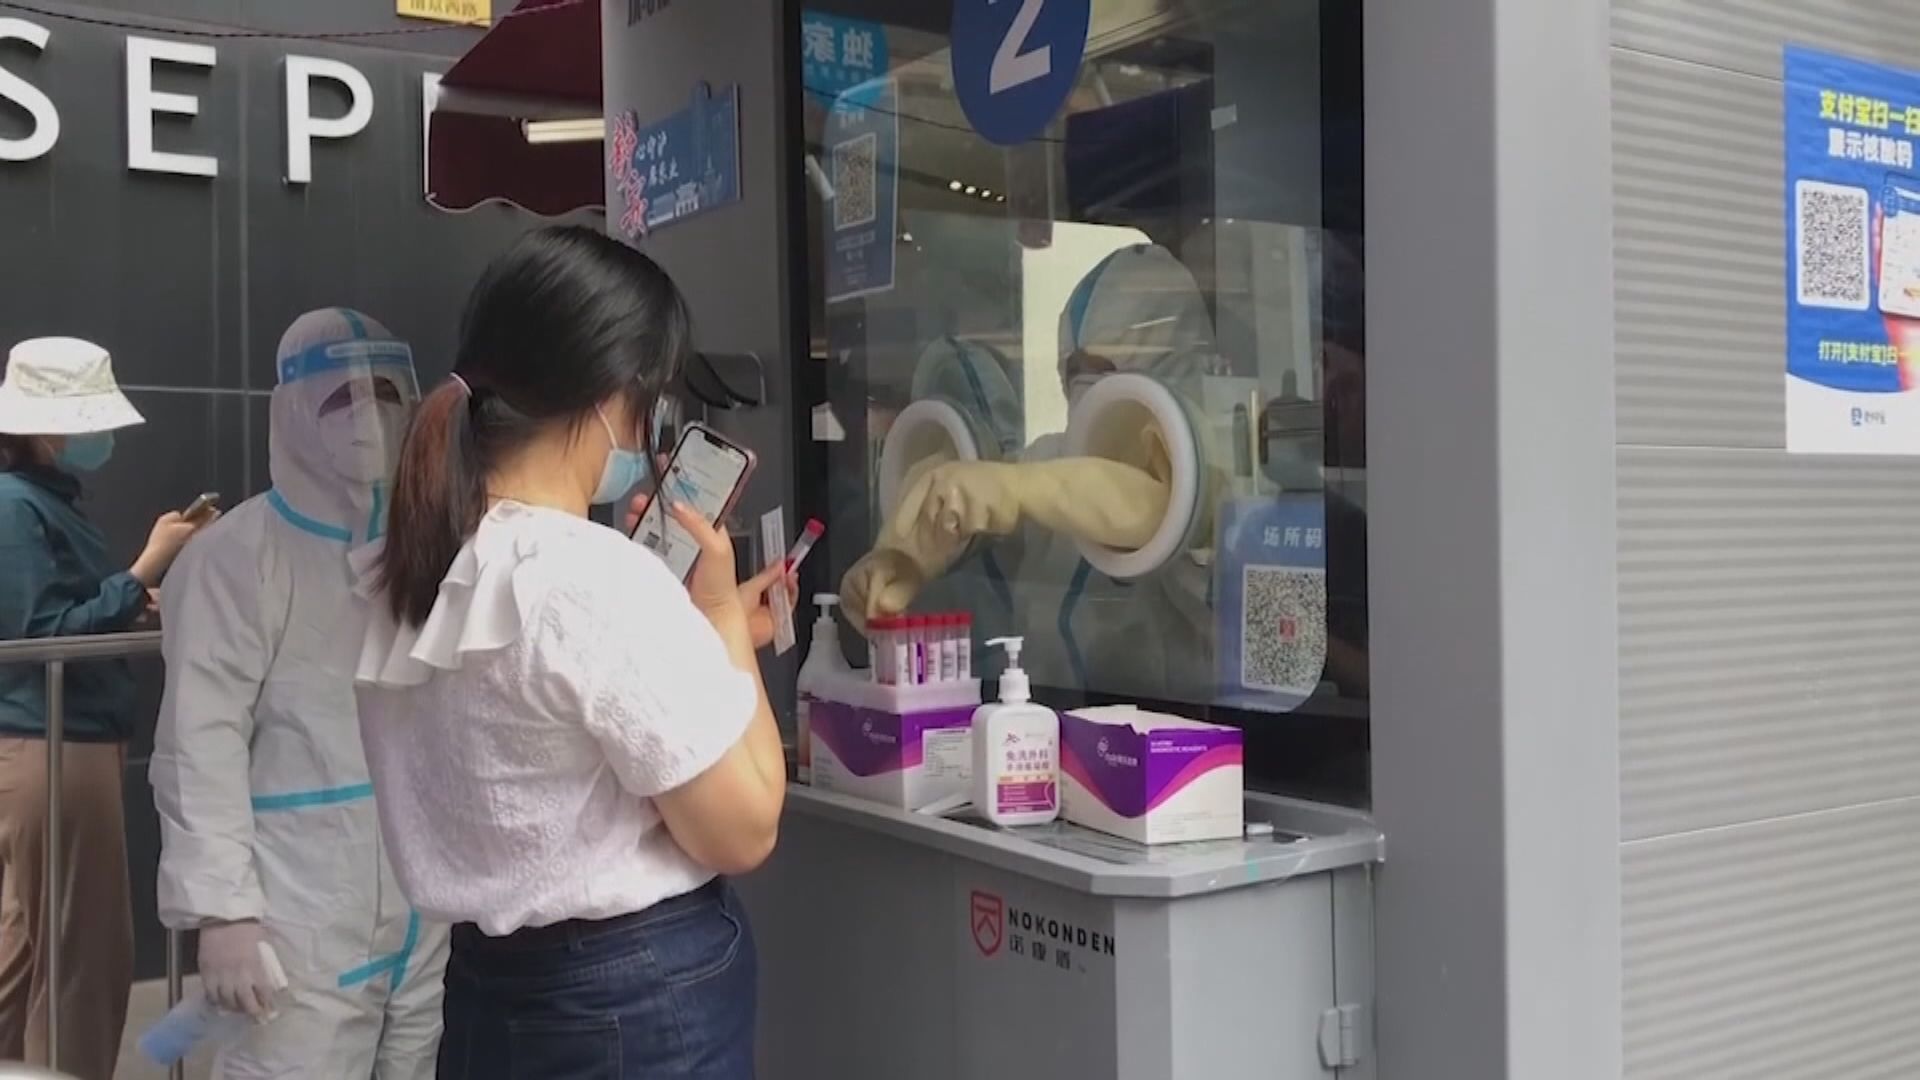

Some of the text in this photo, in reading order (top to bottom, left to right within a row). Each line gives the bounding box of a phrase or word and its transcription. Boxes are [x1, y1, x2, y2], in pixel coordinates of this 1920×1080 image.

[990, 0, 1050, 95] 2
[0, 16, 443, 201] SEP
[1828, 127, 1913, 169] 展示核酸码
[1263, 525, 1322, 549] 场所码
[1008, 907, 1116, 957] NOKONDEN
